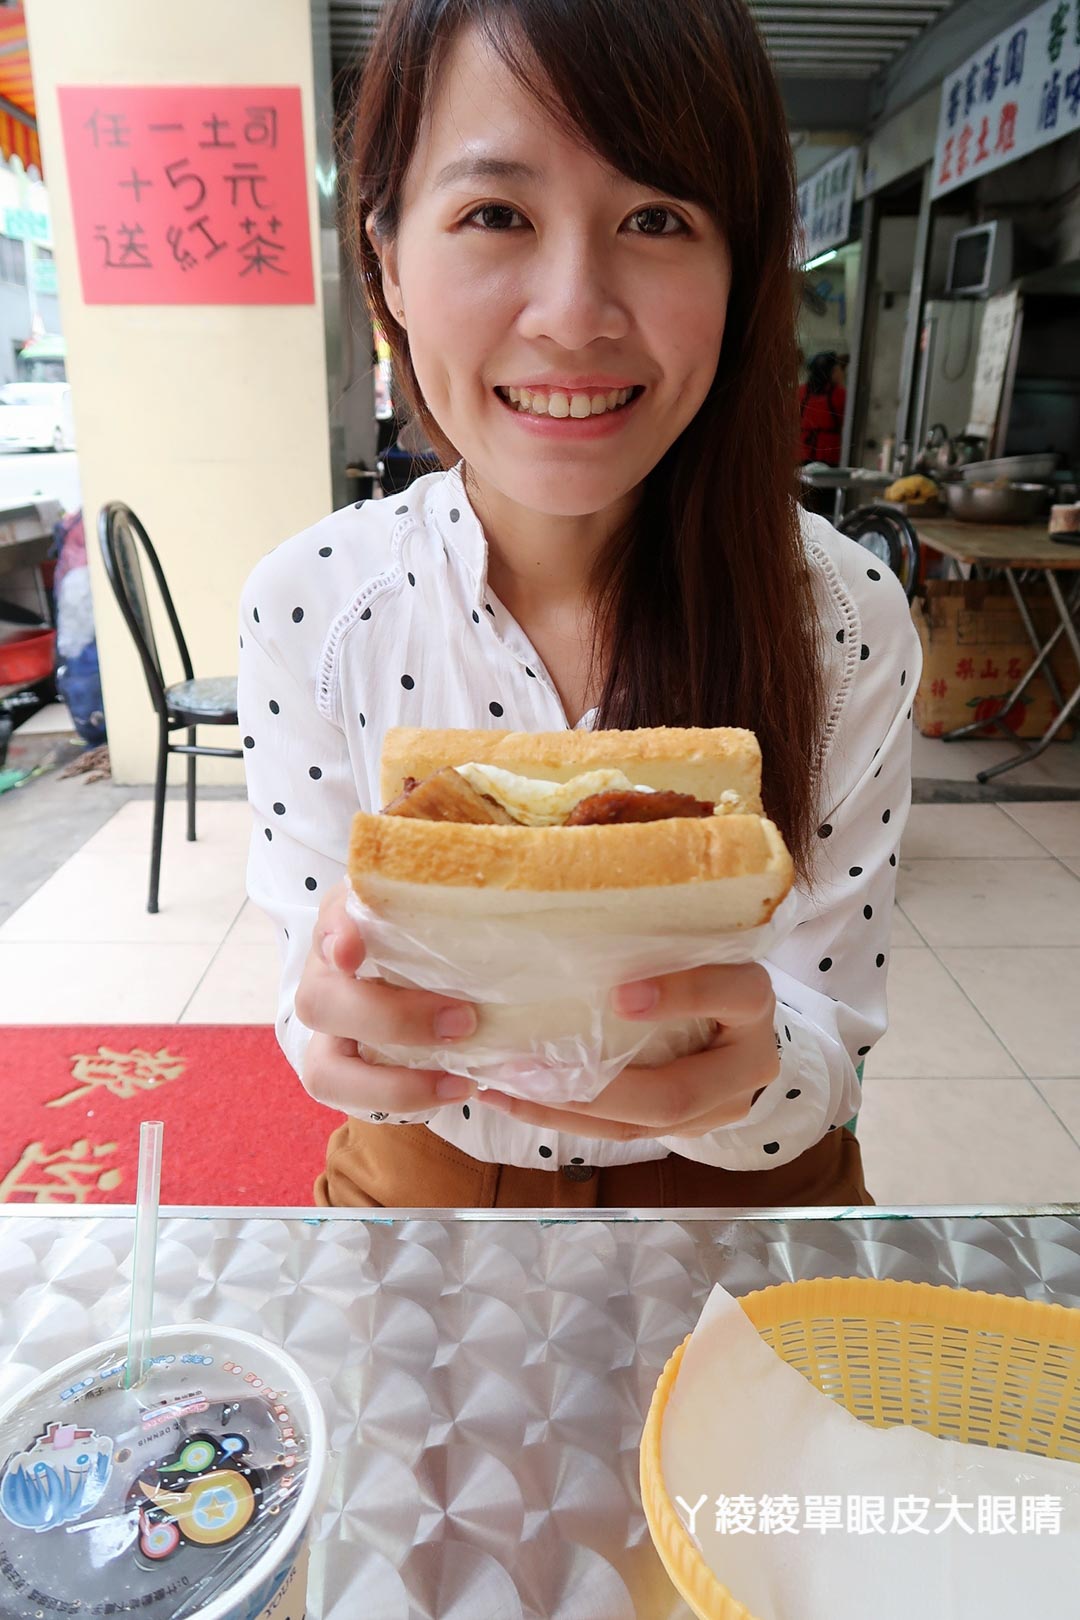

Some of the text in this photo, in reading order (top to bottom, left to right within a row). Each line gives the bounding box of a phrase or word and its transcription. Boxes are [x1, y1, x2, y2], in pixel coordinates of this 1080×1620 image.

[84, 106, 278, 148] 任一土司
[118, 157, 273, 212] +5元
[93, 215, 289, 278] 送紅茶
